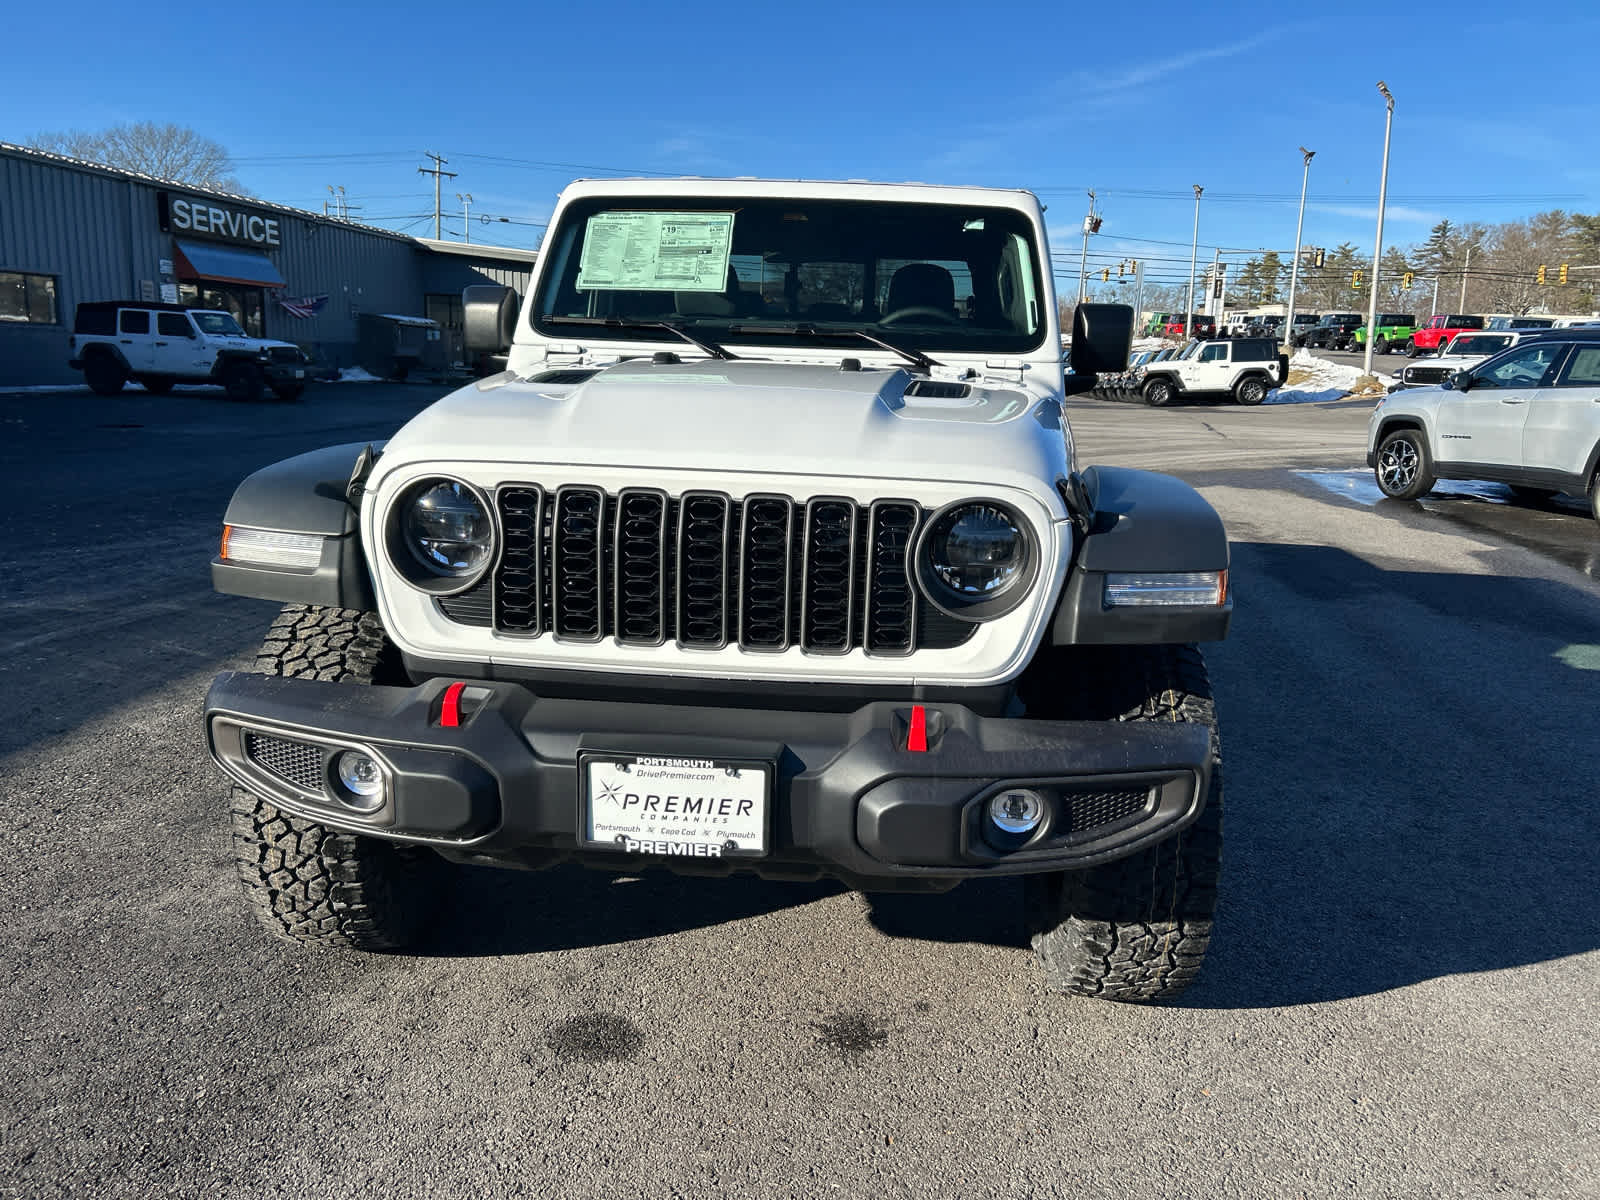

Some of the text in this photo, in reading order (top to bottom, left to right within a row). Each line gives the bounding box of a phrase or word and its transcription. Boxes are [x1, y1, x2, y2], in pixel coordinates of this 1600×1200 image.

[173, 199, 280, 245] SERVICE
[636, 757, 714, 769] PORTSMOUTH
[636, 769, 715, 781] DrivePremier.com
[622, 793, 753, 816] PREMIER
[640, 813, 728, 824] COMPANIES
[595, 823, 756, 840] Portsmouth Cape Cod Plymouth
[625, 840, 722, 857] PREMIER
